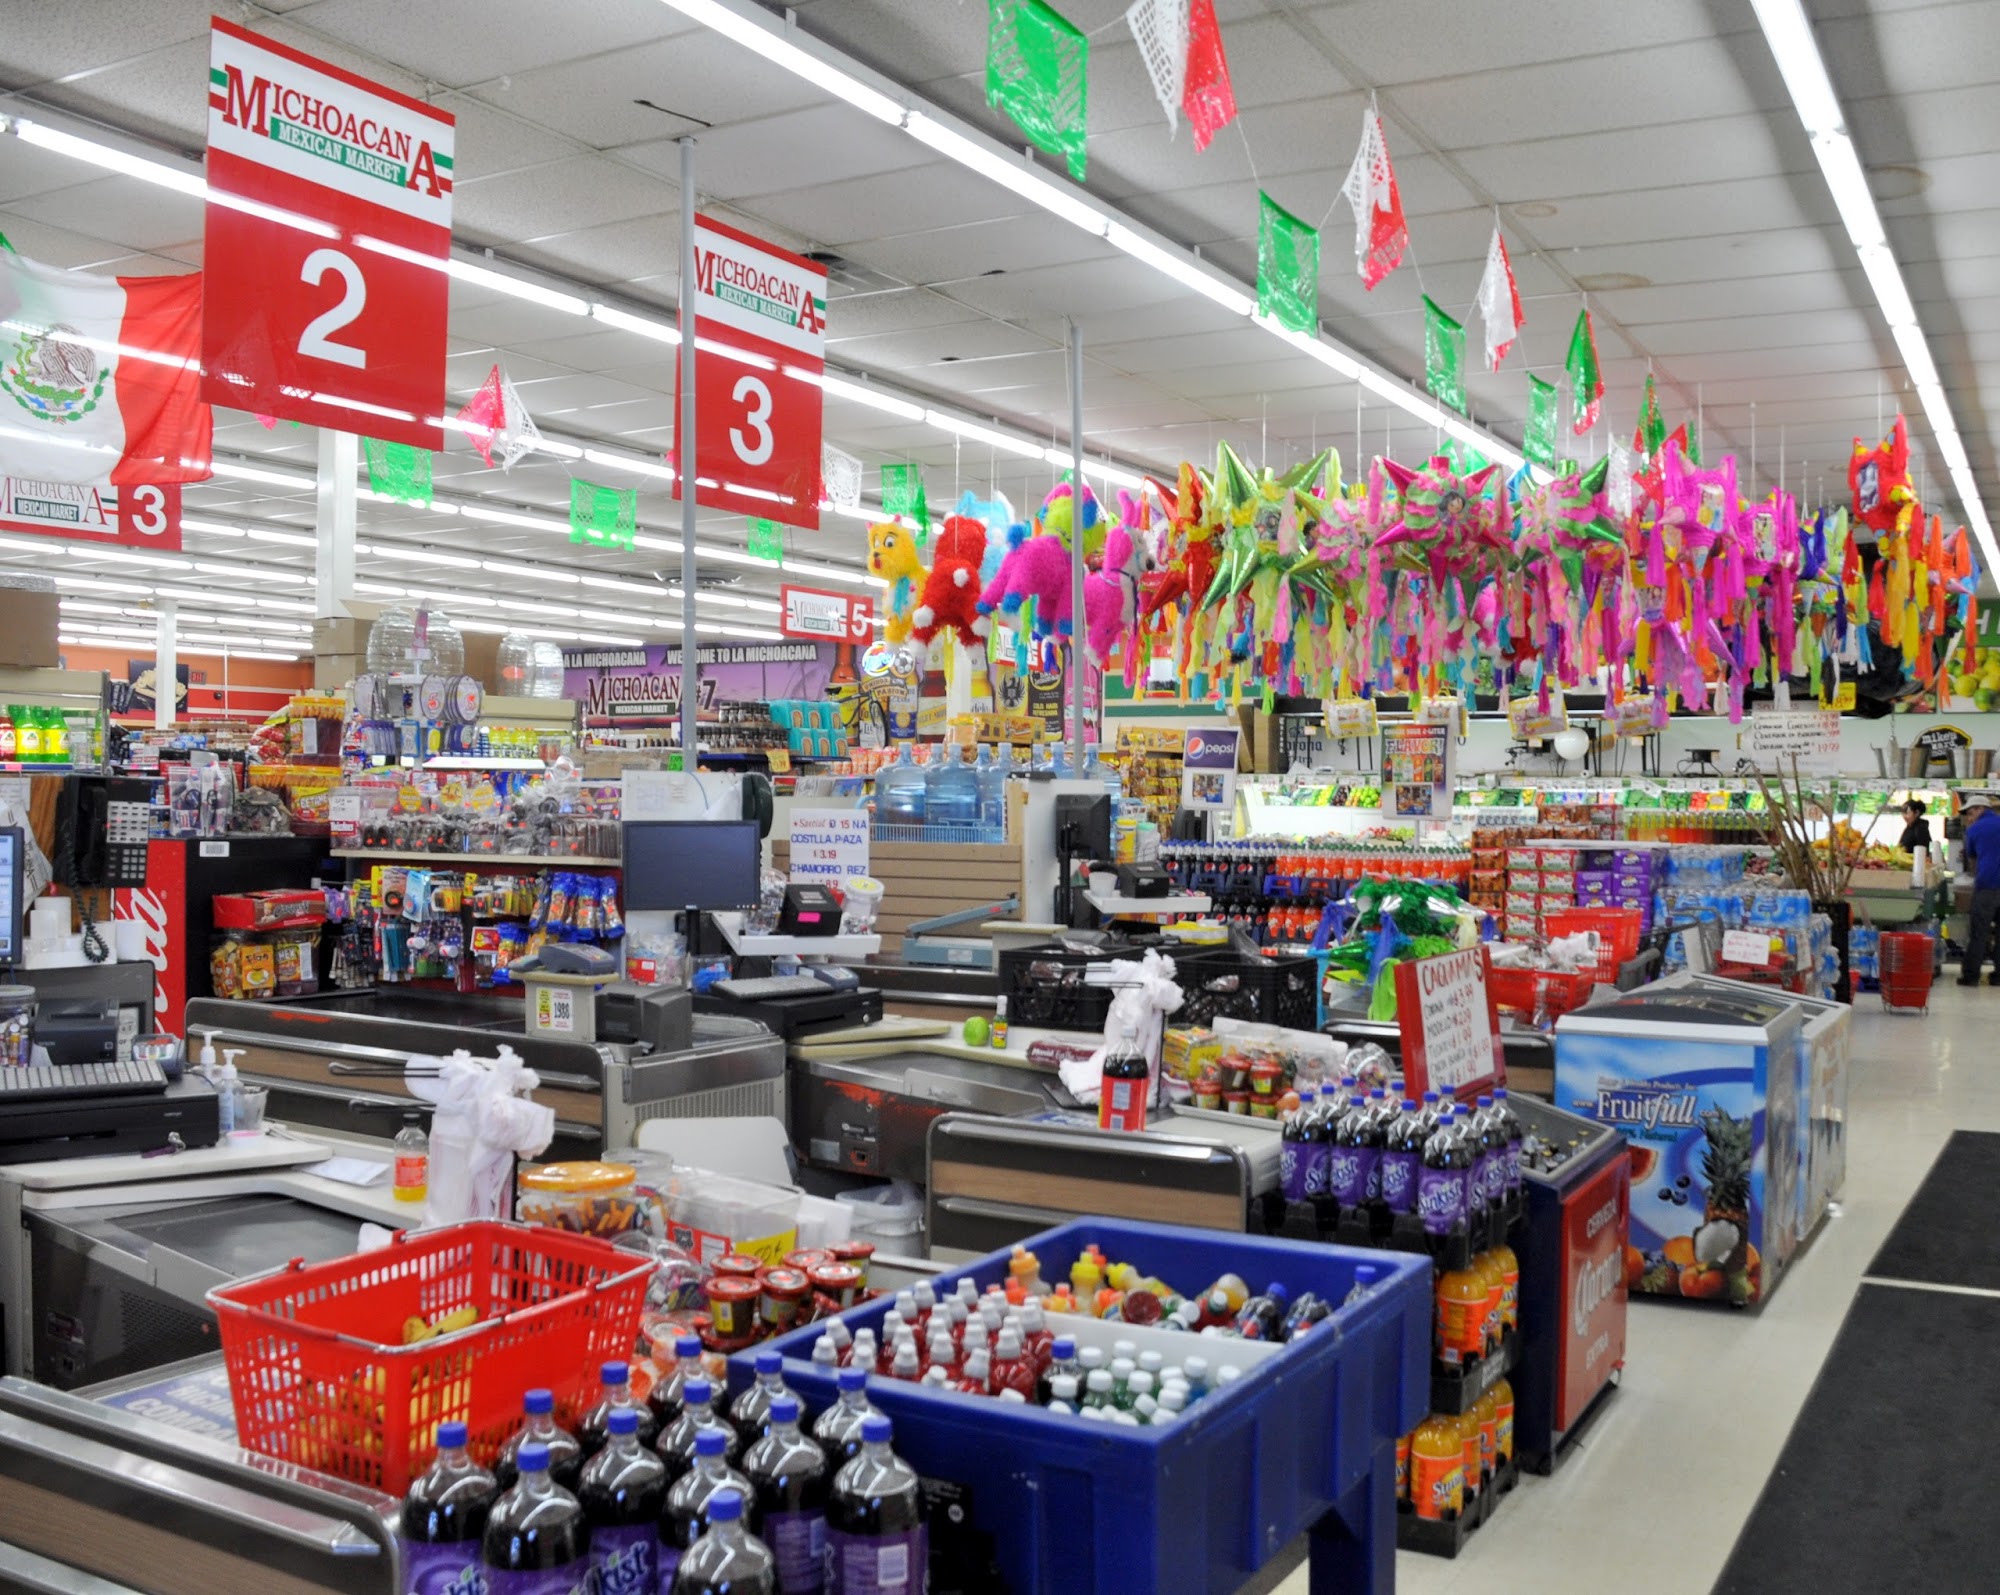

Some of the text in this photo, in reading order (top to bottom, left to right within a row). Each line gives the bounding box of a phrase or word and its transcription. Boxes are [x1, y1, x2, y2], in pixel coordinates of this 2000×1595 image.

[222, 63, 442, 199] MICHOACANA
[278, 121, 400, 183] MEXICAN MARKET
[297, 249, 367, 370] 2
[719, 283, 794, 324] MEXICAN MARKET
[729, 375, 774, 466] 3
[17, 500, 79, 521] MEXICAN MARKET
[132, 484, 168, 535] 3
[851, 602, 867, 637] 5
[571, 653, 583, 667] LA
[584, 651, 647, 668] MICHOACANA
[716, 648, 729, 663] TO
[732, 647, 745, 662] LA
[745, 645, 817, 663] MICHOACANA
[588, 675, 682, 716] MICHOACAN
[615, 704, 668, 714] MEXICAN MARKET
[1205, 743, 1234, 756] pepsi
[1386, 738, 1445, 756] FLAVOR!
[846, 865, 867, 875] REZ
